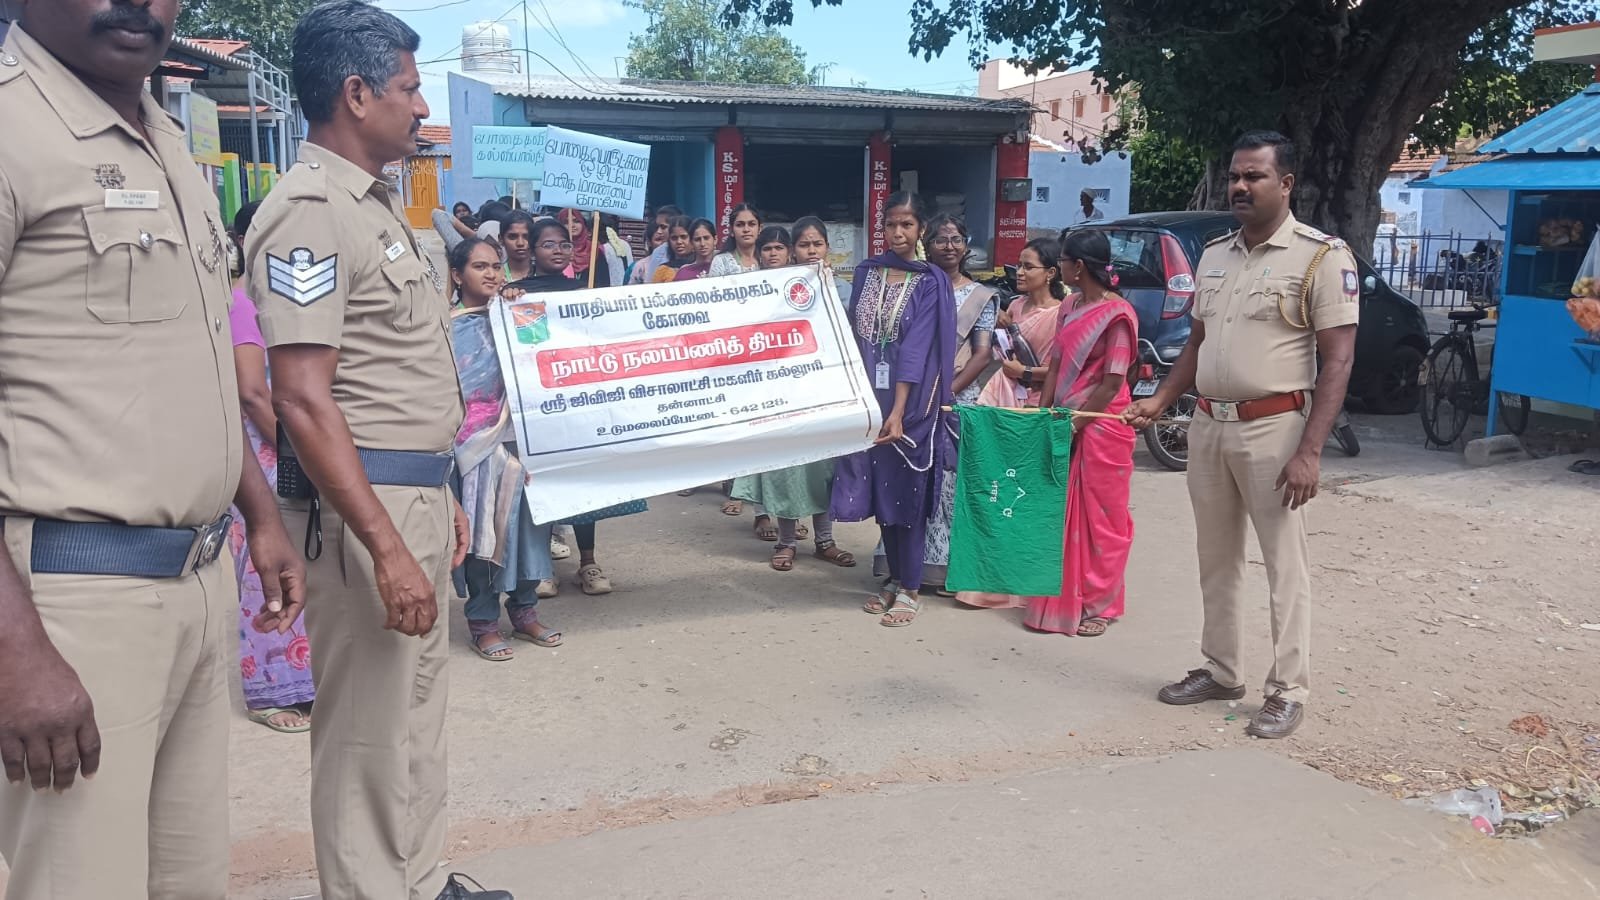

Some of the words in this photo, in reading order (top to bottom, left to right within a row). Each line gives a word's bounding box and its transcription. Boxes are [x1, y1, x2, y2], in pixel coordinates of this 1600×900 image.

[558, 295, 638, 320] பாரதியார்
[641, 279, 779, 308] பல்கலைக்கழகம்,
[642, 311, 711, 330] கோவை
[551, 353, 619, 380] நாட்டு
[622, 335, 745, 373] நலப்பணித்
[748, 328, 805, 358] திட்டம்
[570, 386, 625, 408] ஜிவிஜி
[628, 376, 711, 399] விசாலாட்சி
[713, 369, 763, 388] மகளிர்
[766, 359, 824, 379] கல்லூரி
[596, 411, 719, 436] உடுமலைப்பேட்டை
[730, 404, 759, 416] 642
[657, 393, 726, 414] தன்னாட்சி
